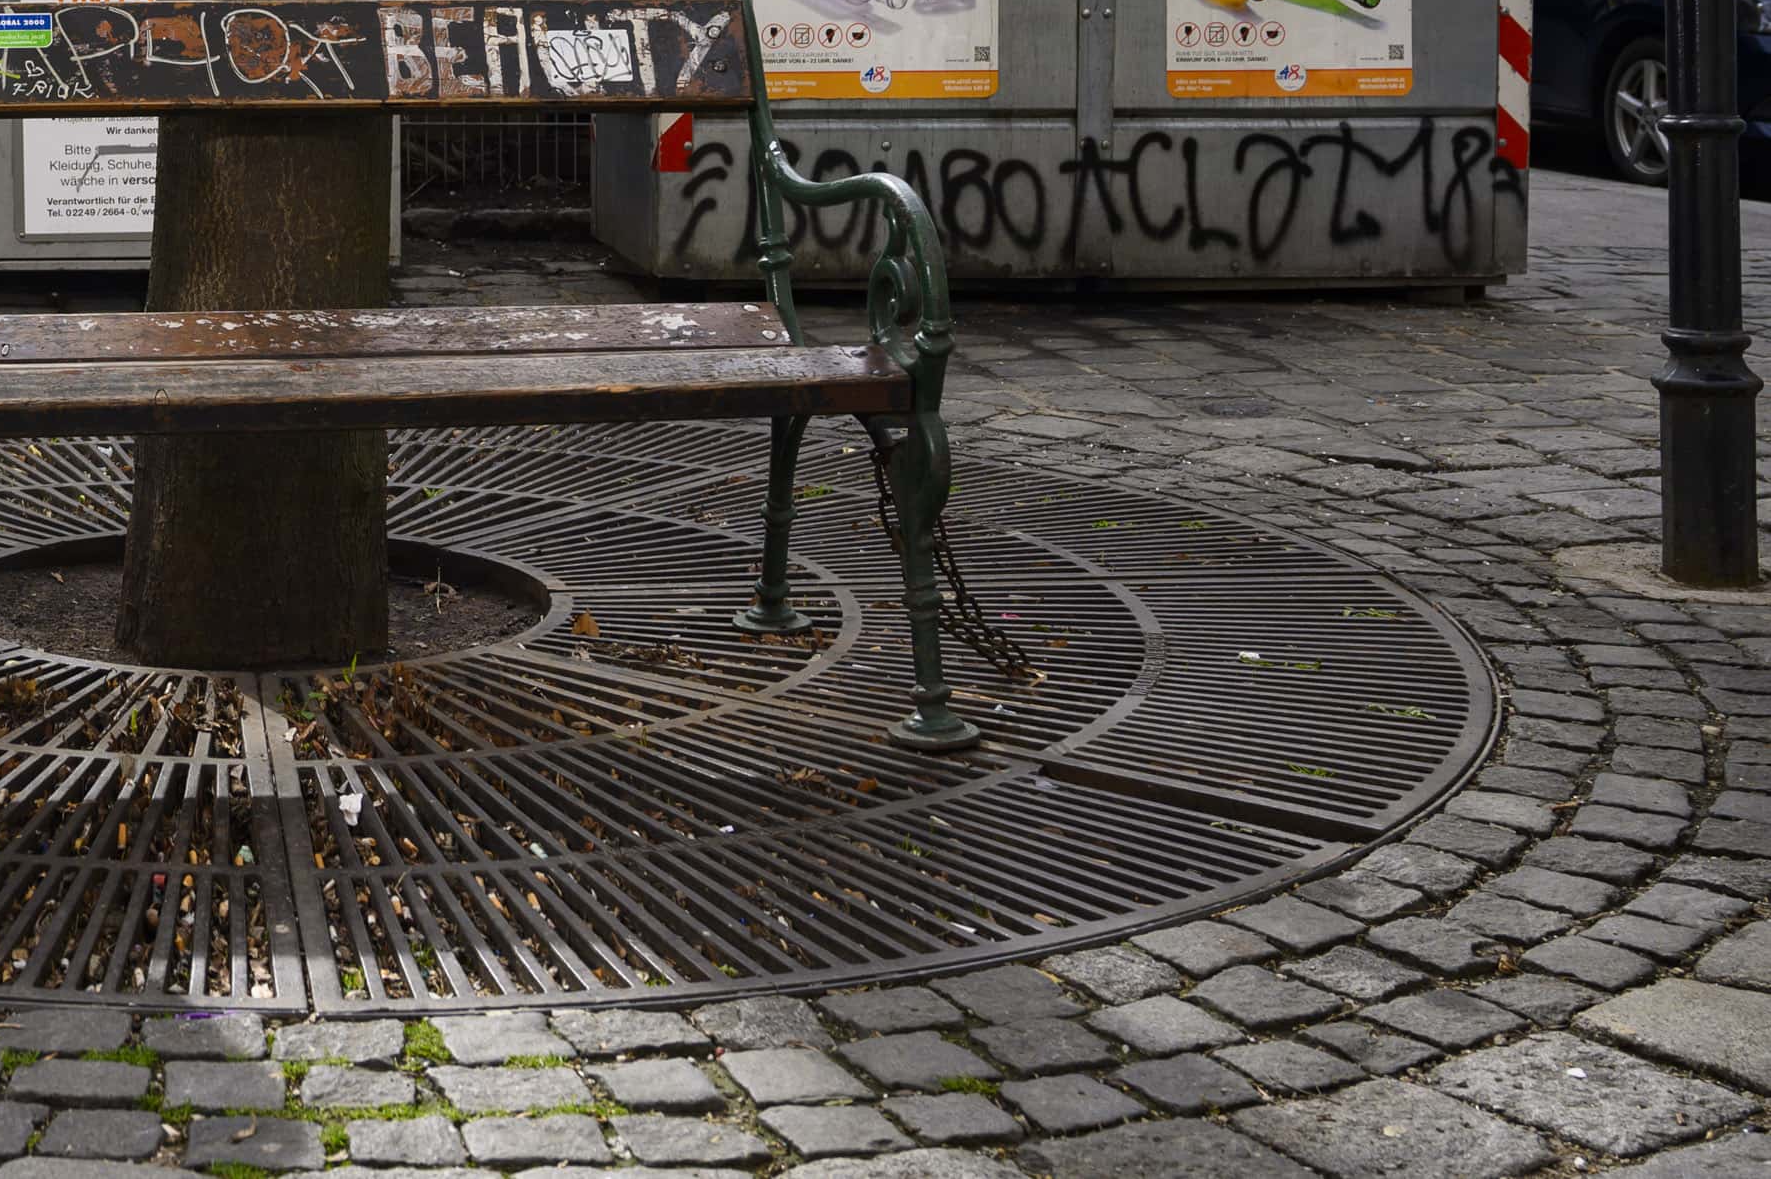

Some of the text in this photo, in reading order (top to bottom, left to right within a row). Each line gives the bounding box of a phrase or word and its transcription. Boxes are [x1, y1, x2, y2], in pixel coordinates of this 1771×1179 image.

[23, 17, 46, 26] 2000
[865, 66, 885, 81] 48
[1280, 64, 1301, 80] 48
[106, 126, 158, 135] Wir danken
[64, 144, 92, 155] Bitte
[49, 158, 155, 172] Kleidung, Schuhe,
[109, 176, 119, 185] in
[47, 196, 116, 206] Verantwortlich
[118, 196, 131, 204] für
[134, 194, 148, 204] die
[47, 208, 64, 218] Tel.
